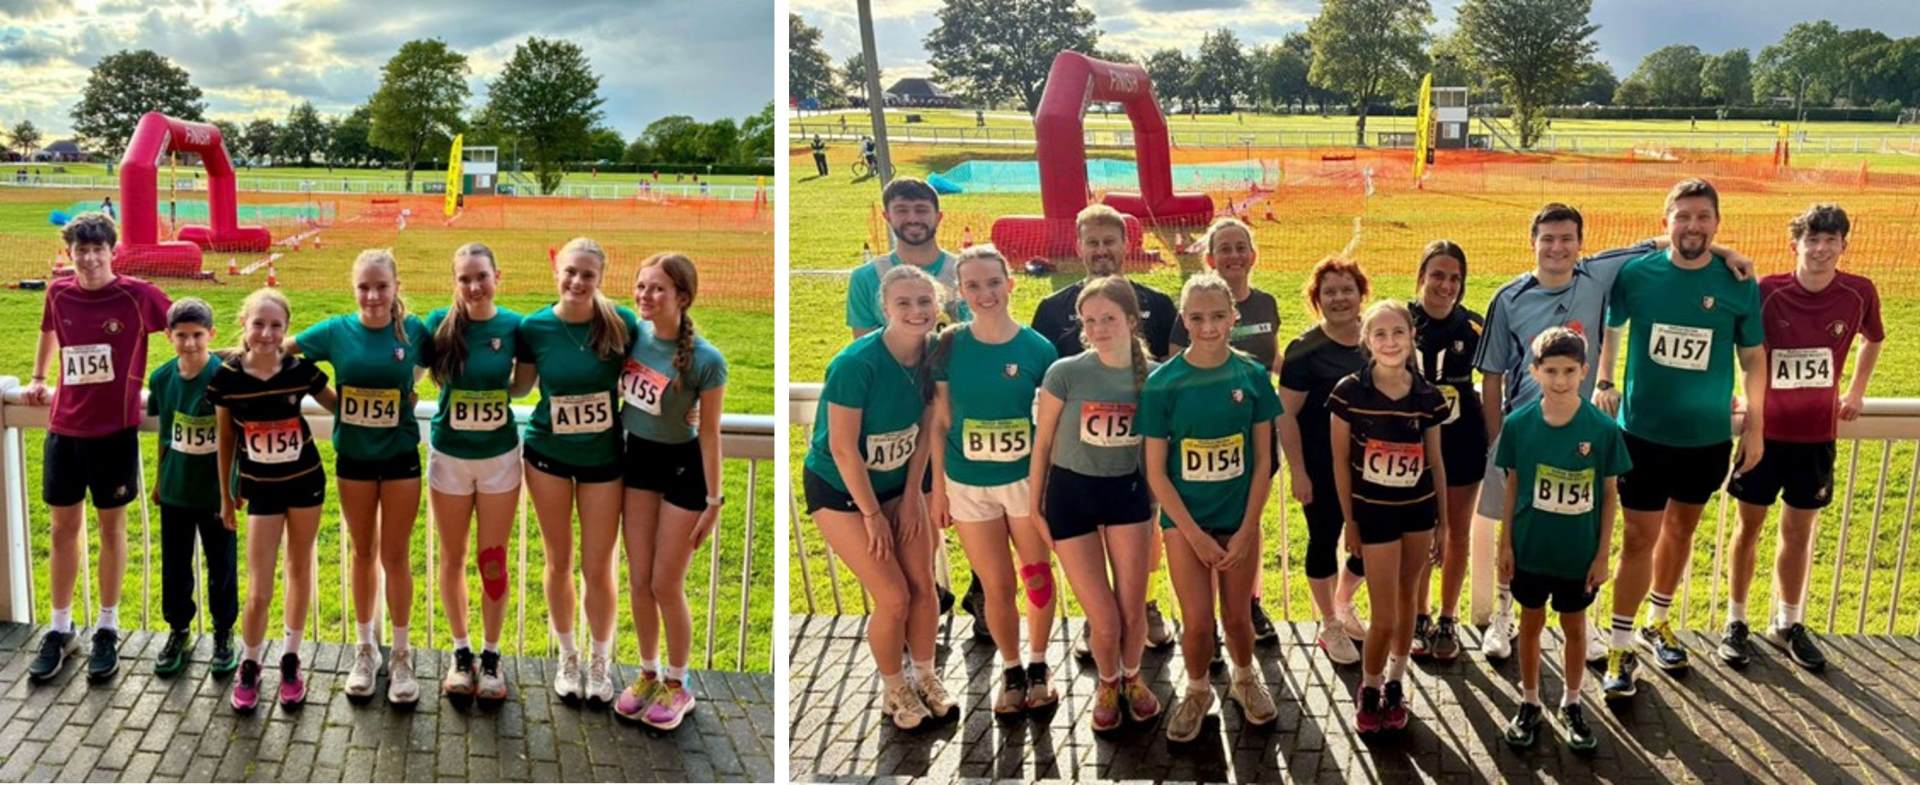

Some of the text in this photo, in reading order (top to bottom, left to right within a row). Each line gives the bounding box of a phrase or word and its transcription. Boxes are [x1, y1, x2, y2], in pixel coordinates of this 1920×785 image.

[1653, 335, 1709, 361] A157
[66, 355, 110, 377] A154
[1776, 359, 1829, 380] A154
[344, 396, 396, 419] D154
[455, 401, 504, 422] B155
[557, 402, 607, 425] A155
[174, 423, 217, 447] B154
[1086, 414, 1139, 438] C15
[250, 430, 300, 454] C154
[870, 433, 914, 466] A155
[969, 430, 1027, 453] B155
[1186, 447, 1241, 472] D154
[1369, 451, 1420, 477] C154
[1538, 477, 1591, 506] B154
